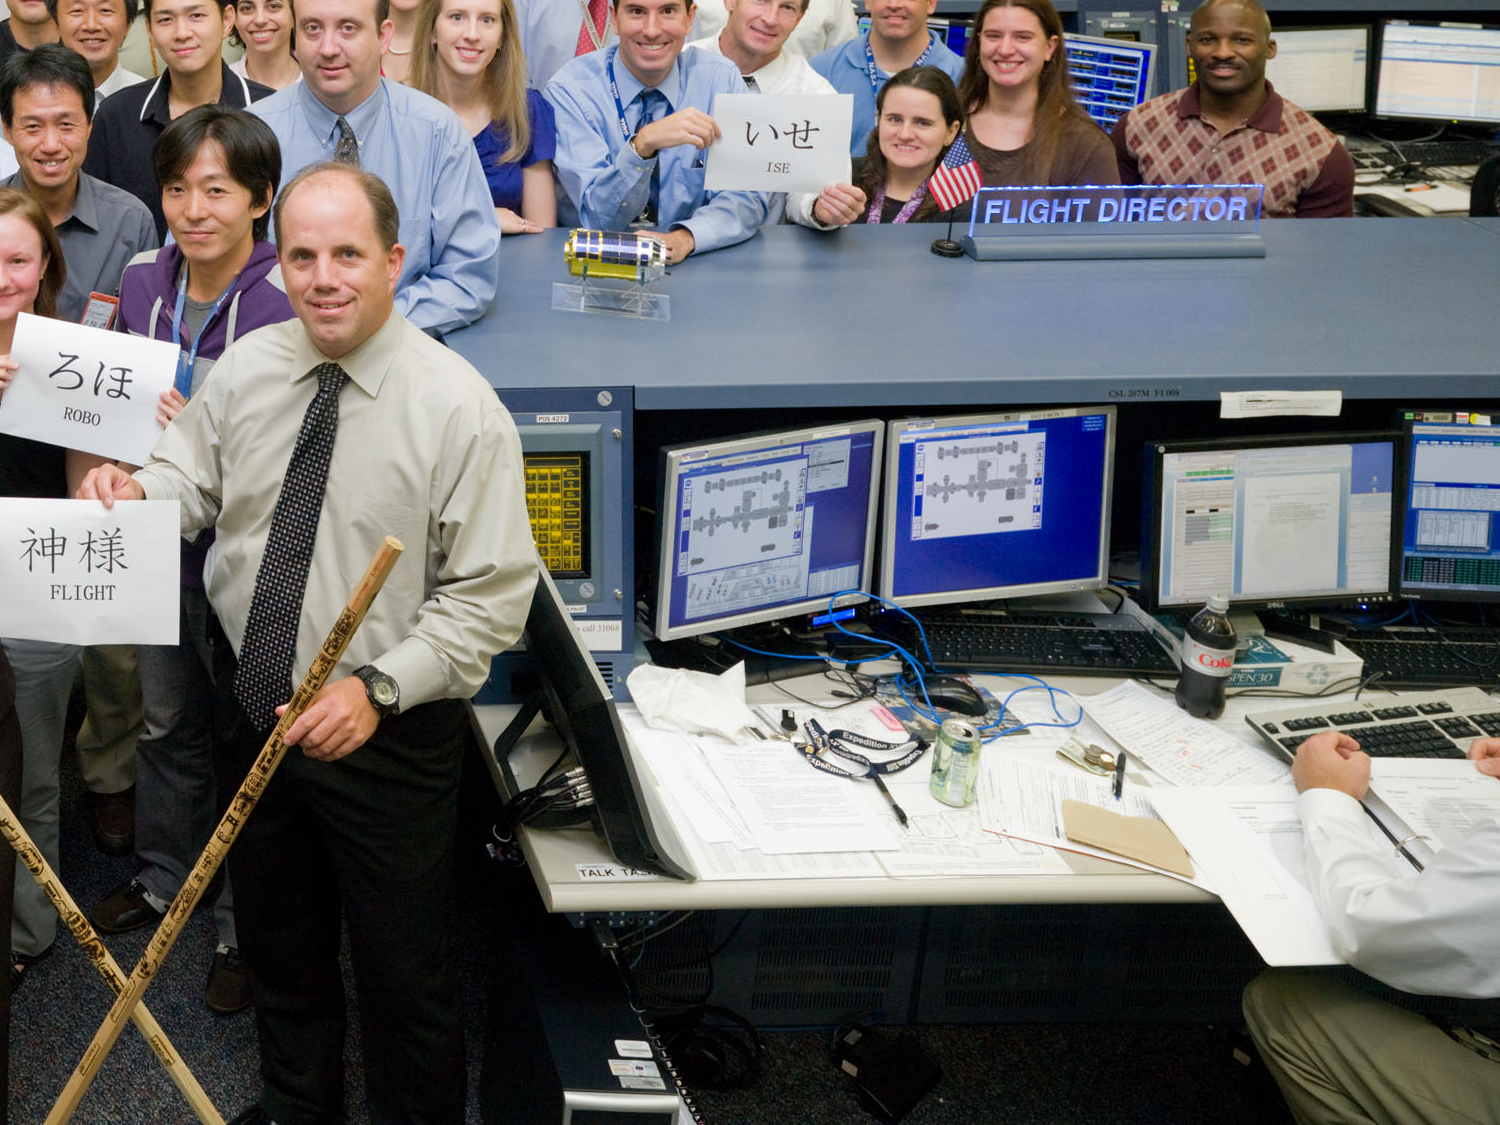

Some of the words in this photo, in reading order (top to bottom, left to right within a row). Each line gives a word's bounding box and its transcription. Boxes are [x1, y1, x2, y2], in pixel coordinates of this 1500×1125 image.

[868, 62, 877, 86] NASA
[745, 119, 820, 150] いせ
[767, 162, 790, 174] ISE
[984, 198, 1092, 224] FLIGHT
[1097, 196, 1248, 223] DIRECTOR
[48, 350, 132, 401] ろほ
[62, 406, 101, 427] ROBO
[17, 526, 130, 575] 神様
[49, 584, 116, 601] FLIGHT
[582, 624, 596, 632] call
[1199, 653, 1233, 669] Coke
[1255, 673, 1273, 683] 30
[842, 731, 887, 749] Expedition
[579, 869, 615, 877] TALK
